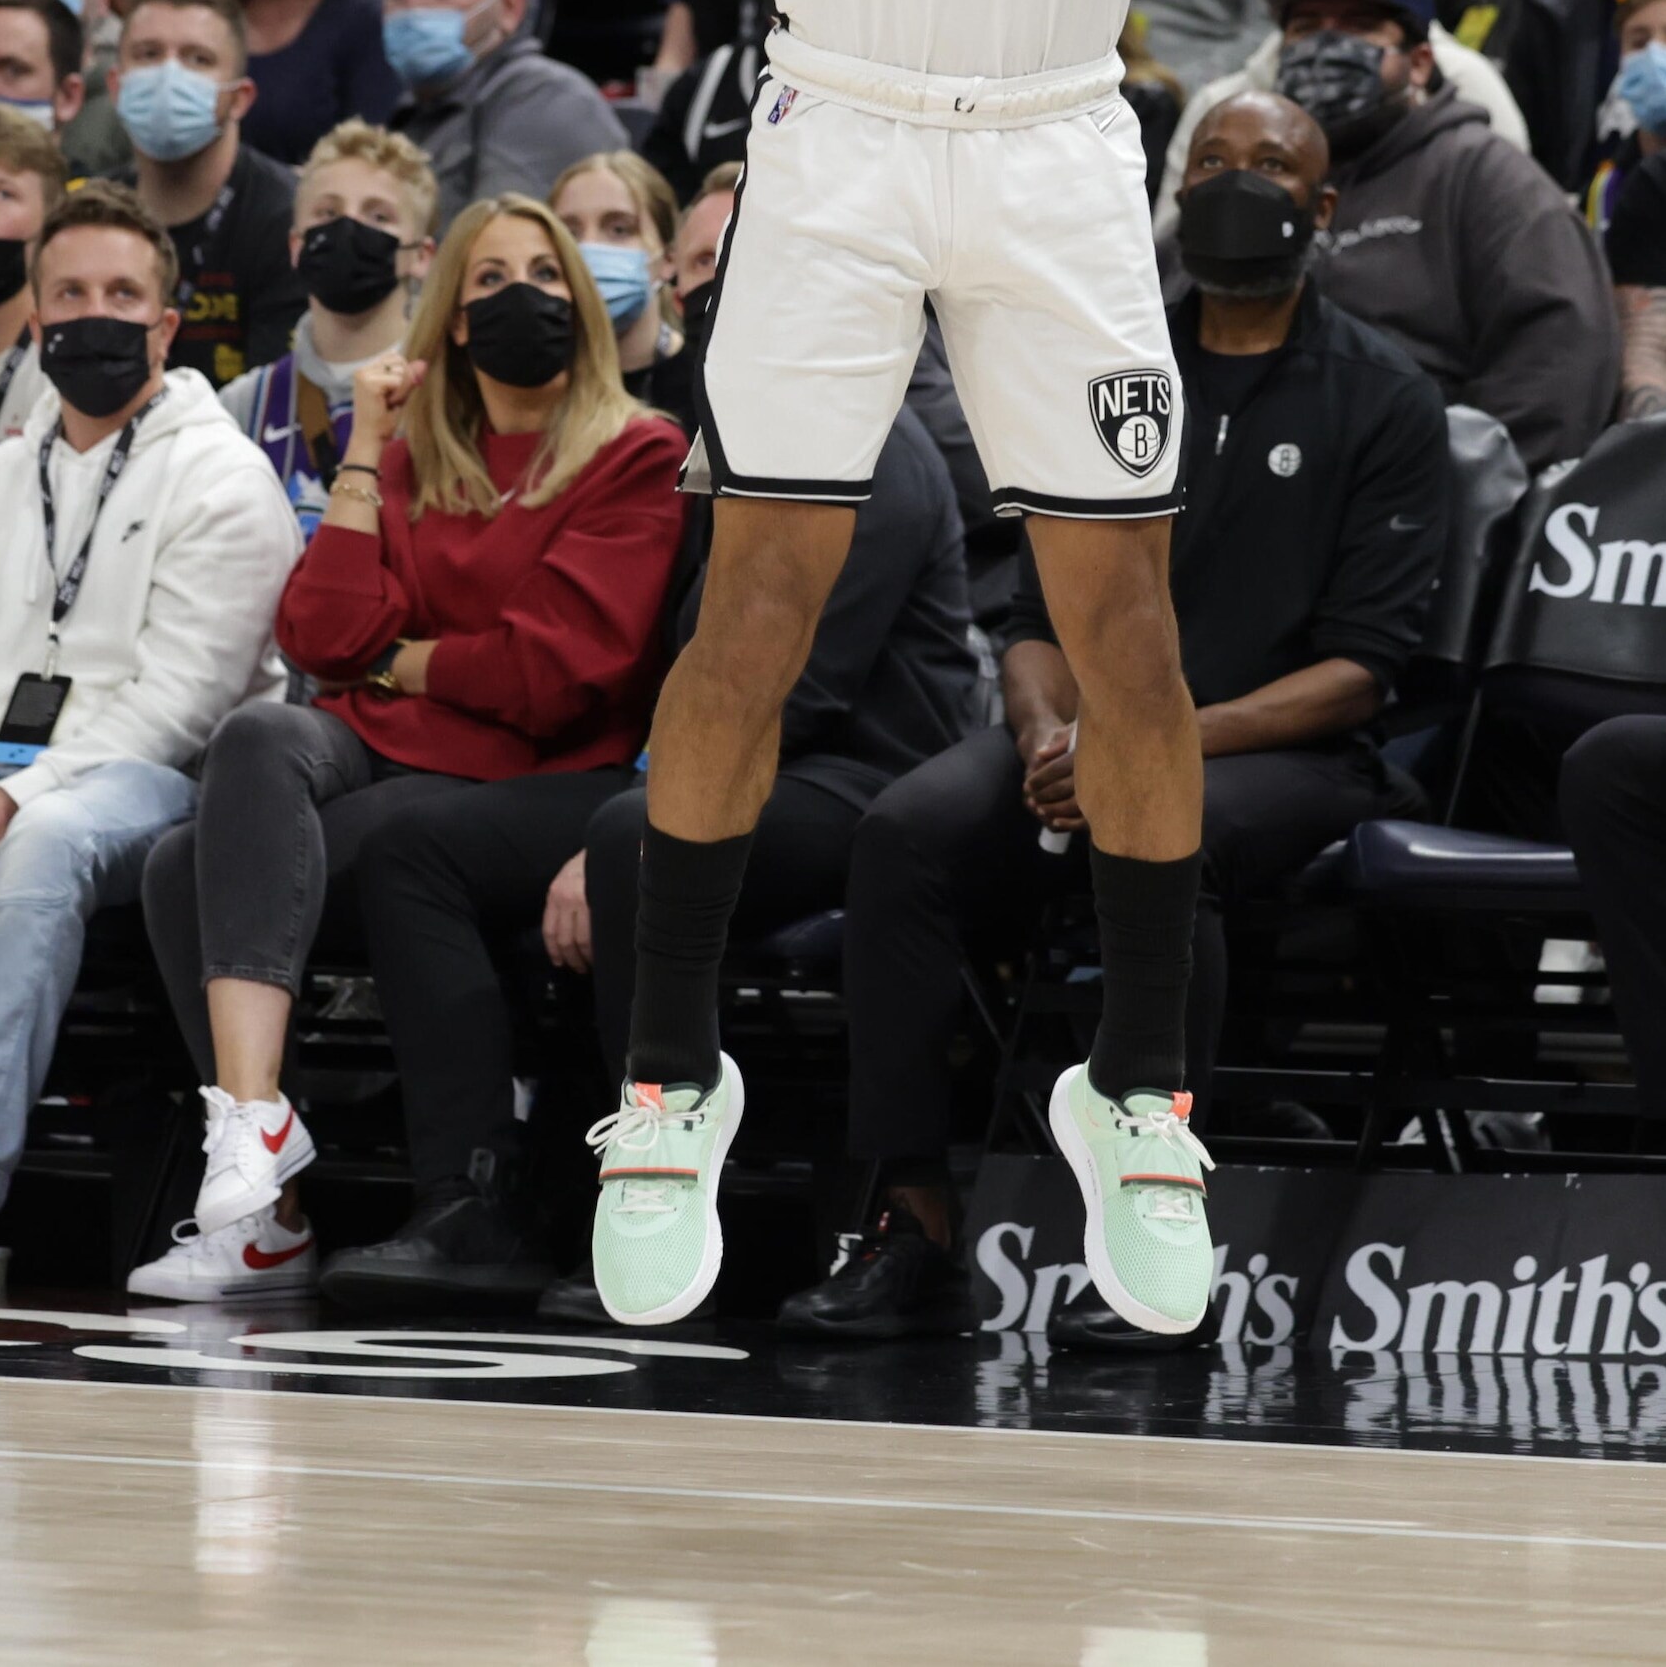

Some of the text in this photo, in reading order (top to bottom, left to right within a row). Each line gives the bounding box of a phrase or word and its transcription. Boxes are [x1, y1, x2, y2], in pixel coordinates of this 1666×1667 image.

[1098, 375, 1171, 422] NETS
[1135, 423, 1148, 459] B
[976, 1221, 1300, 1346] Sh's
